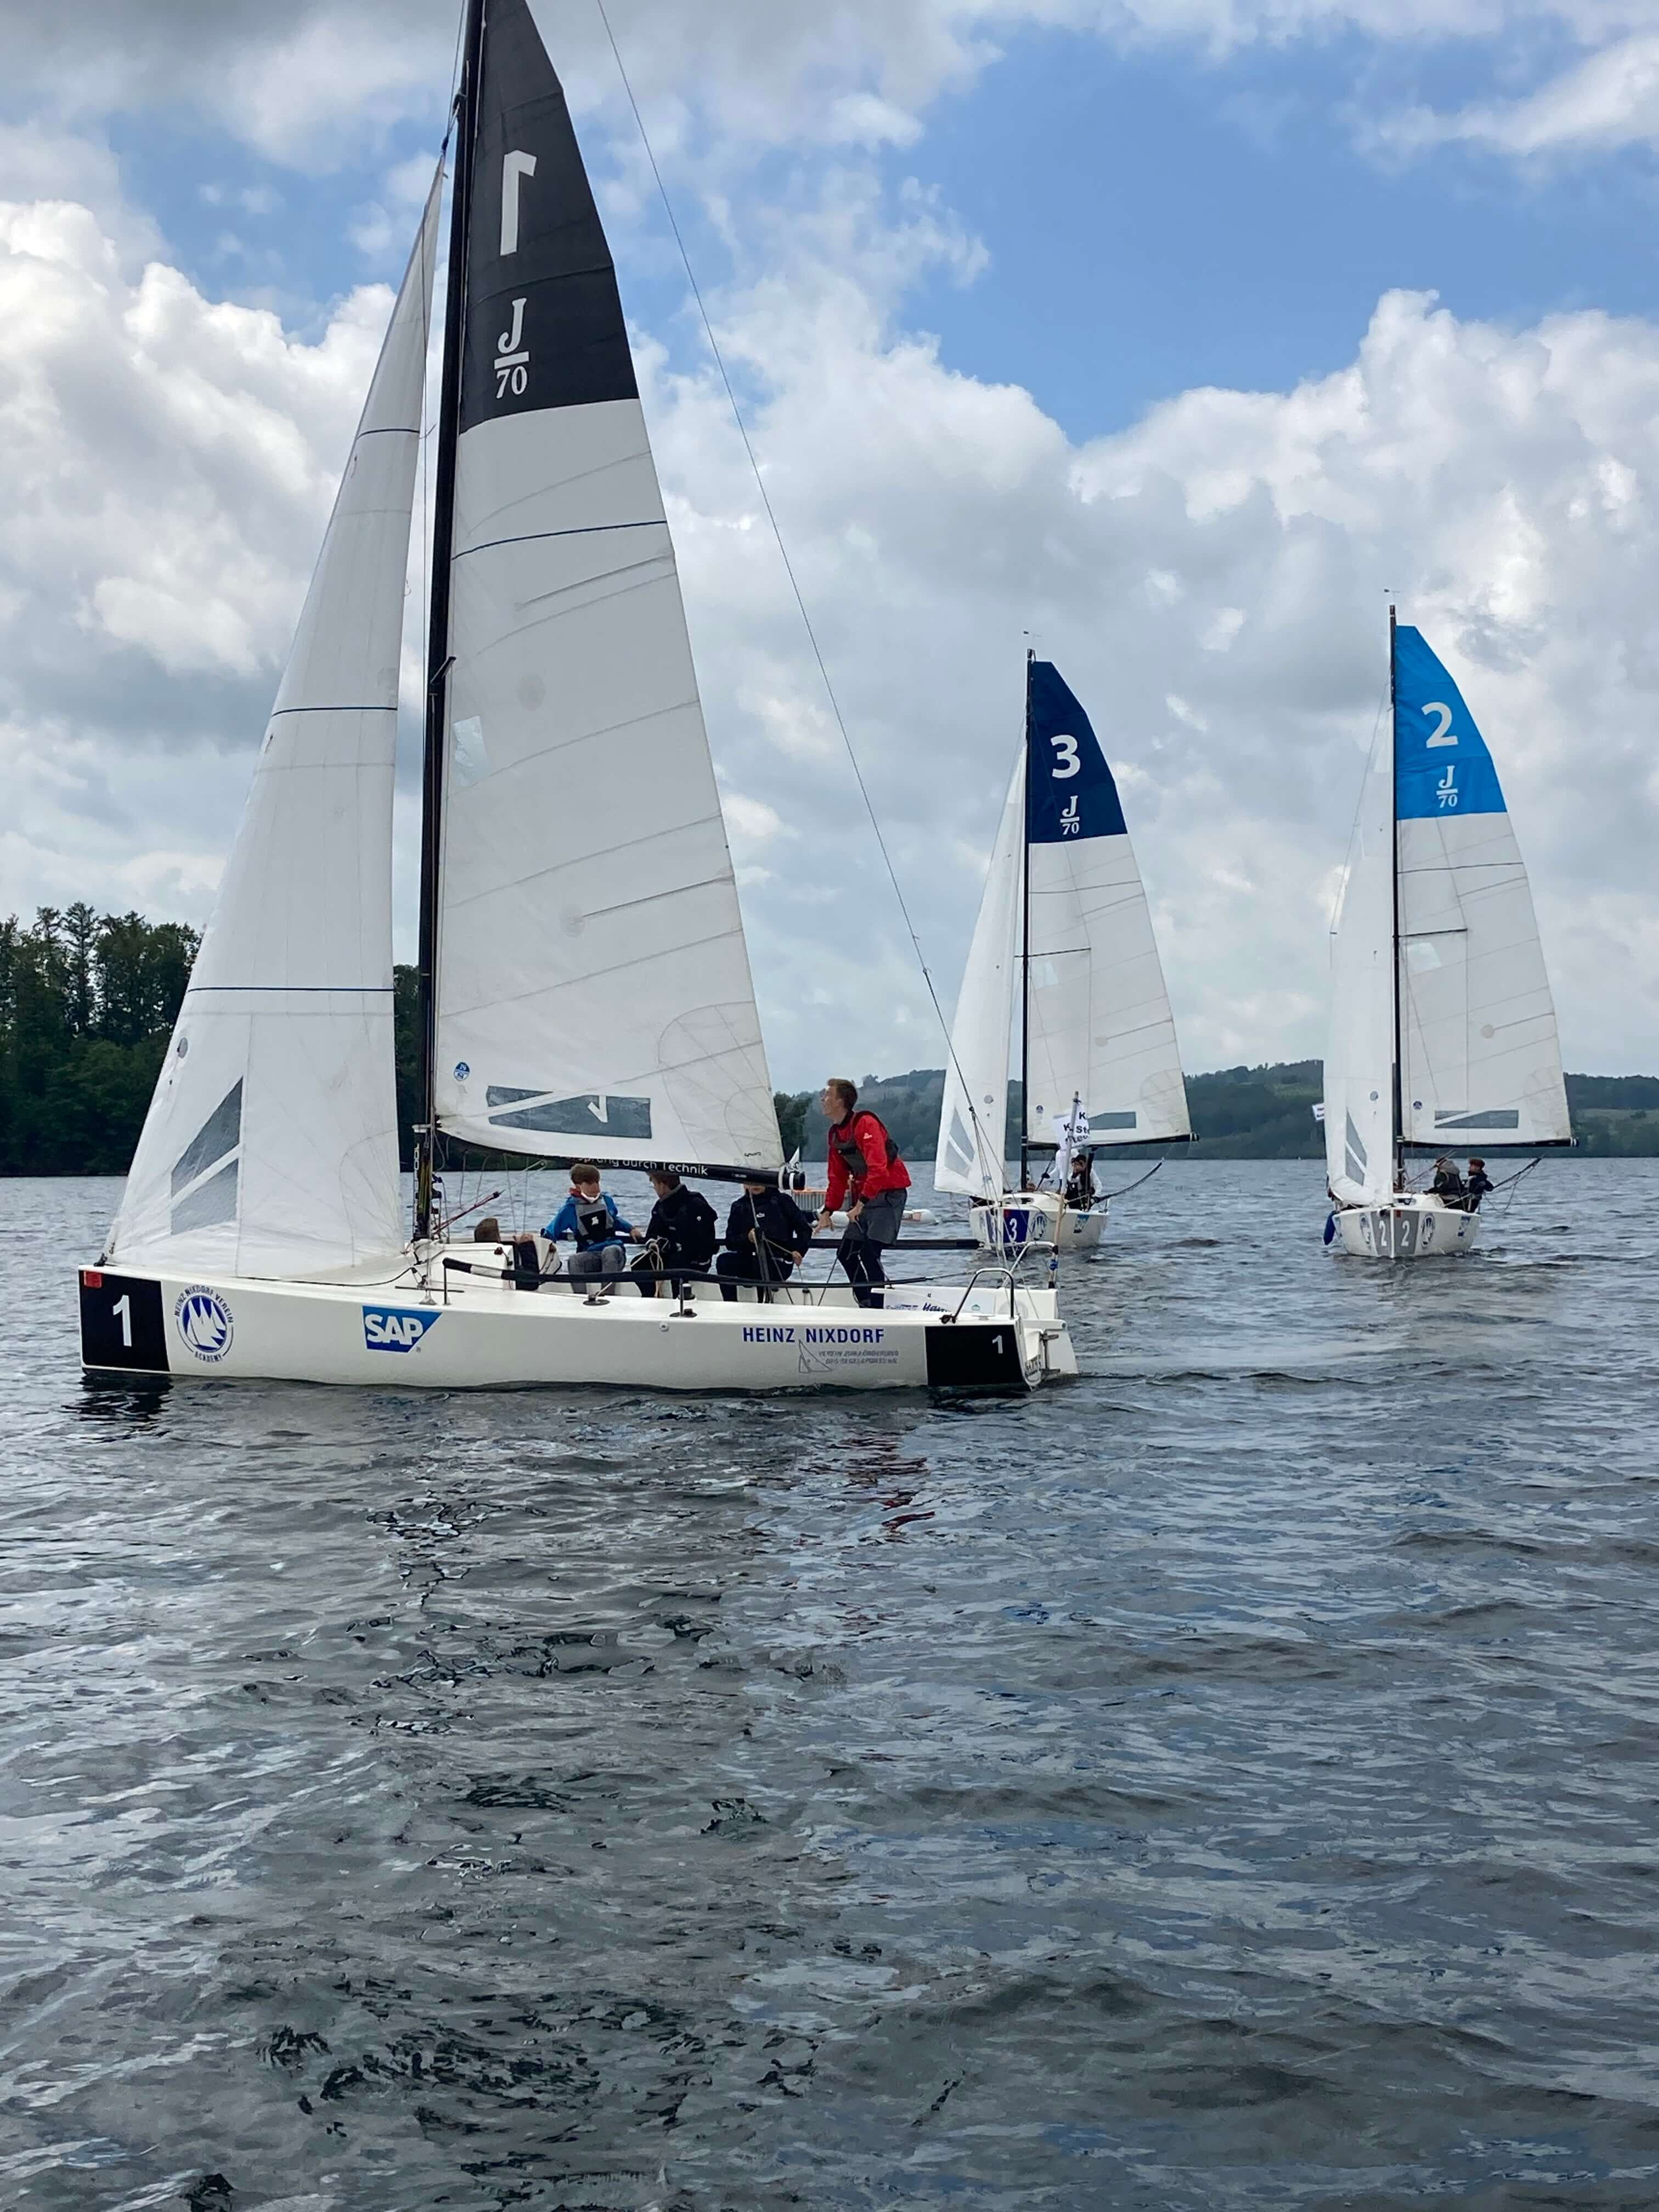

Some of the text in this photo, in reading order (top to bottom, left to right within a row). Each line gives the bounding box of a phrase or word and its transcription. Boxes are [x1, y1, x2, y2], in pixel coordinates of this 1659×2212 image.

[498, 298, 527, 353] J
[496, 365, 528, 399] 70
[1421, 702, 1458, 748] 2
[1050, 734, 1081, 778] 3
[1438, 765, 1455, 788] J
[1062, 795, 1079, 817] J
[1438, 794, 1458, 808] 70
[1062, 822, 1079, 836] 70
[1009, 1218, 1018, 1243] 3
[1379, 1220, 1387, 1247] 2
[1401, 1220, 1410, 1247] 2
[112, 1294, 132, 1347] 1
[215, 1293, 234, 1323] VEREIN
[365, 1313, 424, 1345] SAP
[743, 1327, 884, 1344] HEINZ NIXDORF
[992, 1335, 1003, 1354] 1
